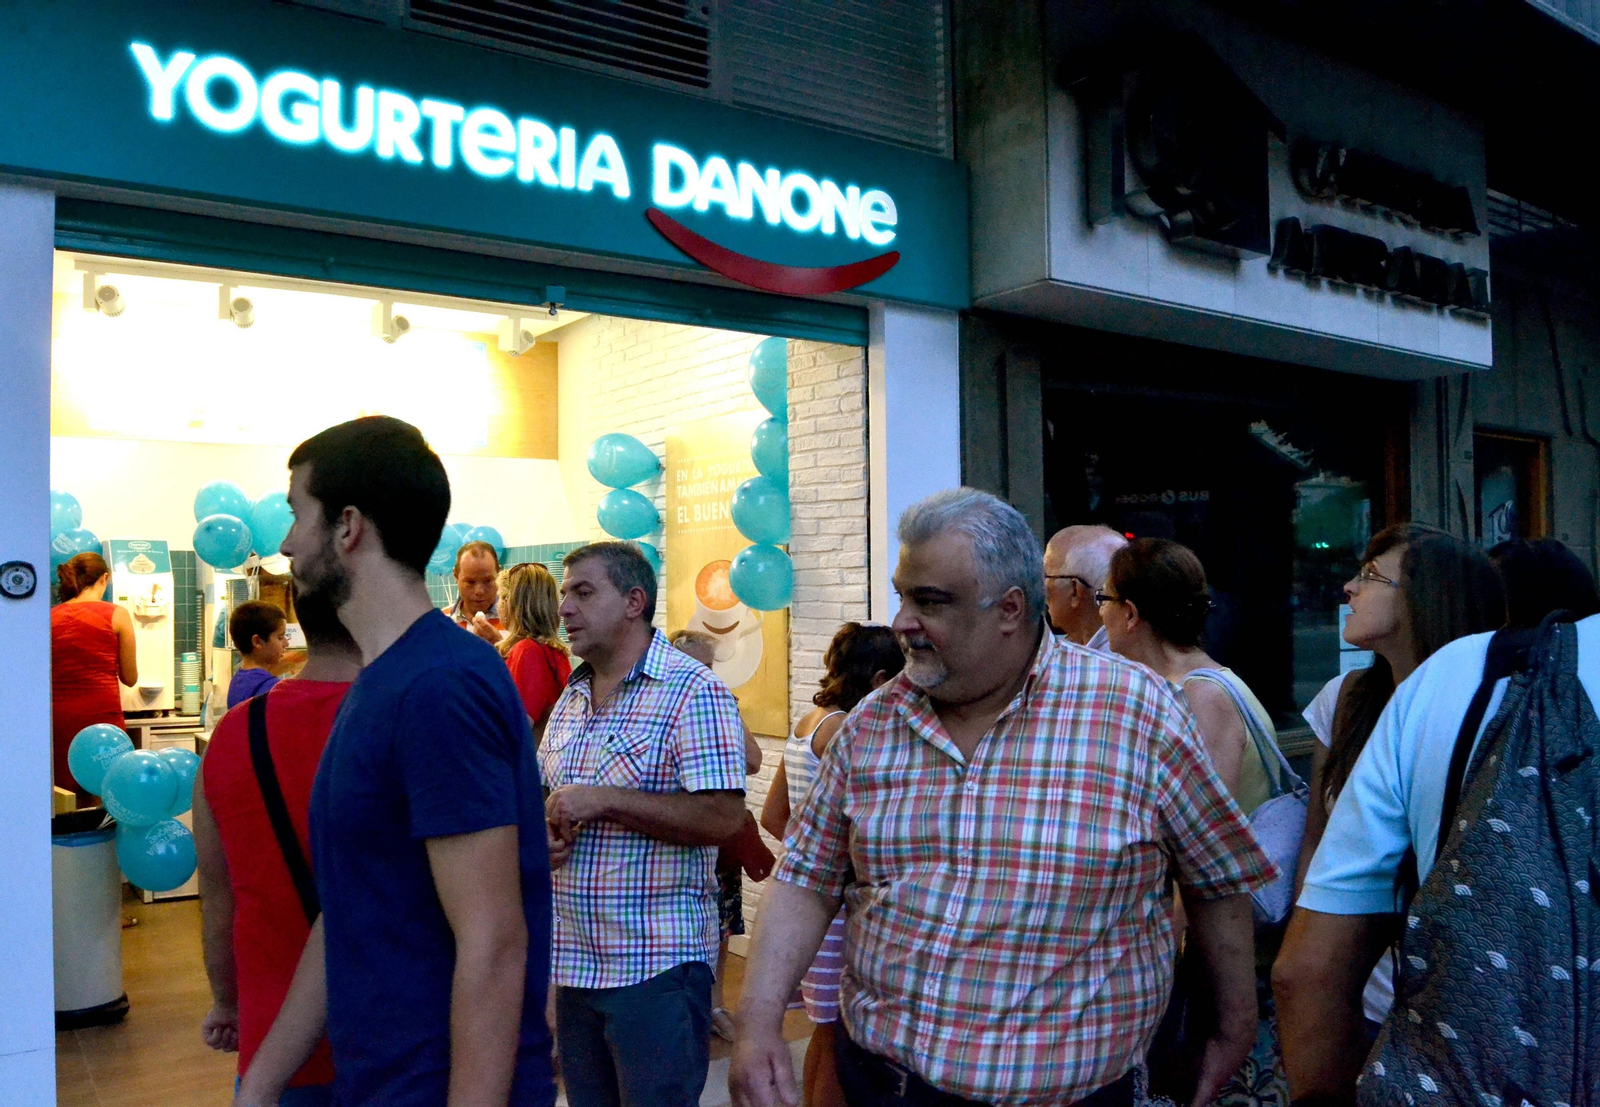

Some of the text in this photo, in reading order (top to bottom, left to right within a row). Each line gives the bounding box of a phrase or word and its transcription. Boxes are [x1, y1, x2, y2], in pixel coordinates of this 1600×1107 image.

[676, 458, 754, 482] EN LA YOGURTE
[677, 500, 730, 524] EL BUEN
